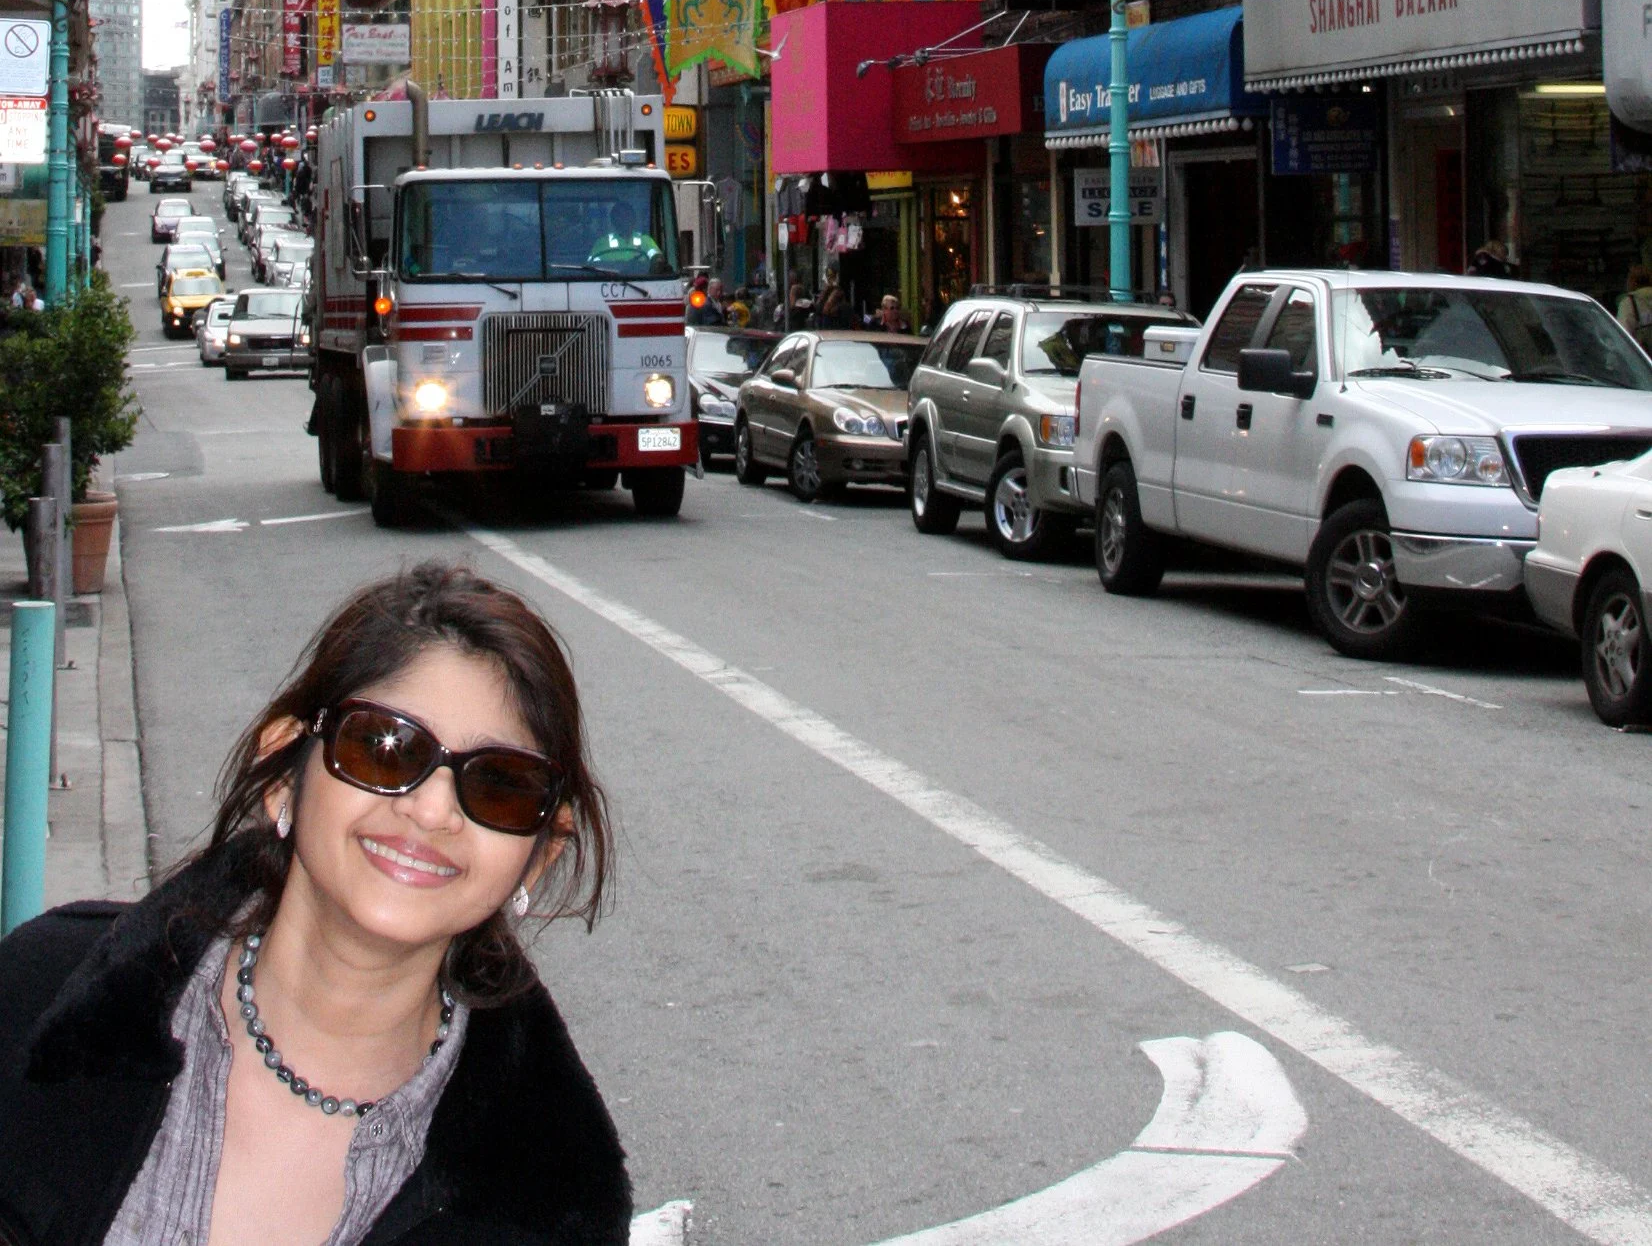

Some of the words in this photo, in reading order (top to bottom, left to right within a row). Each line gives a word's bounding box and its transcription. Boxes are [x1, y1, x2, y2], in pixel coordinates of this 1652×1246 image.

[1069, 88, 1092, 116] Easy
[1095, 82, 1141, 108] Traer
[1188, 78, 1207, 96] GIFTS
[474, 112, 545, 132] LEACH
[7, 139, 29, 150] TIME
[640, 354, 673, 367] 10065
